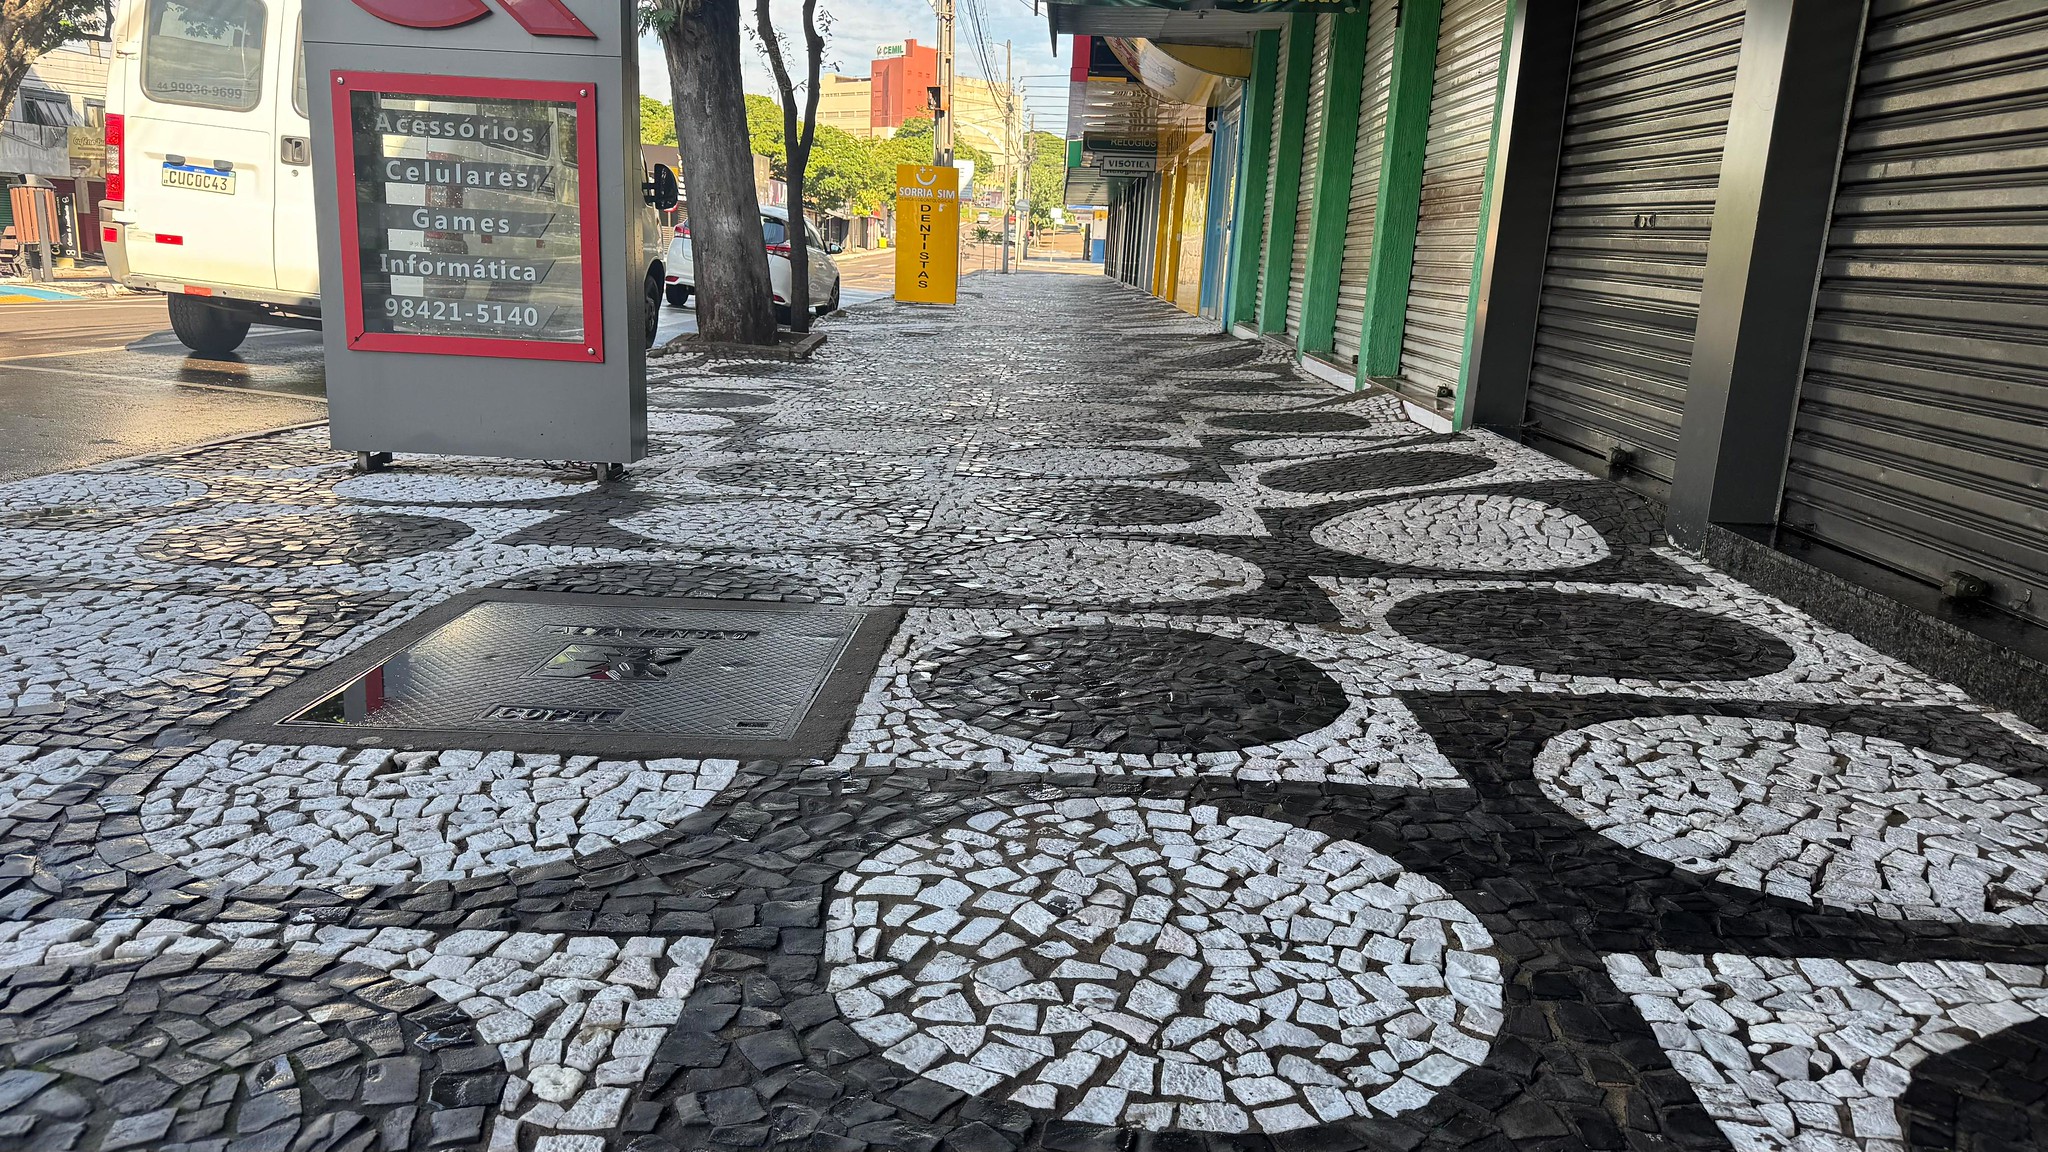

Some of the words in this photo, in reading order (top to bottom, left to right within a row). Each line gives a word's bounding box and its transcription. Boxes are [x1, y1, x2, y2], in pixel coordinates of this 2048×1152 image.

[883, 45, 904, 55] CEMIL
[157, 82, 168, 90] 44
[171, 81, 242, 100] 99936-9699
[375, 112, 534, 143] Acessórios
[385, 160, 528, 189] Celulares
[899, 187, 933, 198] SORRIA
[937, 189, 955, 199] SIM
[412, 208, 510, 233] Games
[918, 204, 932, 289] DENTISTAS
[379, 253, 536, 281] Informática
[385, 298, 538, 326] 98421-5140
